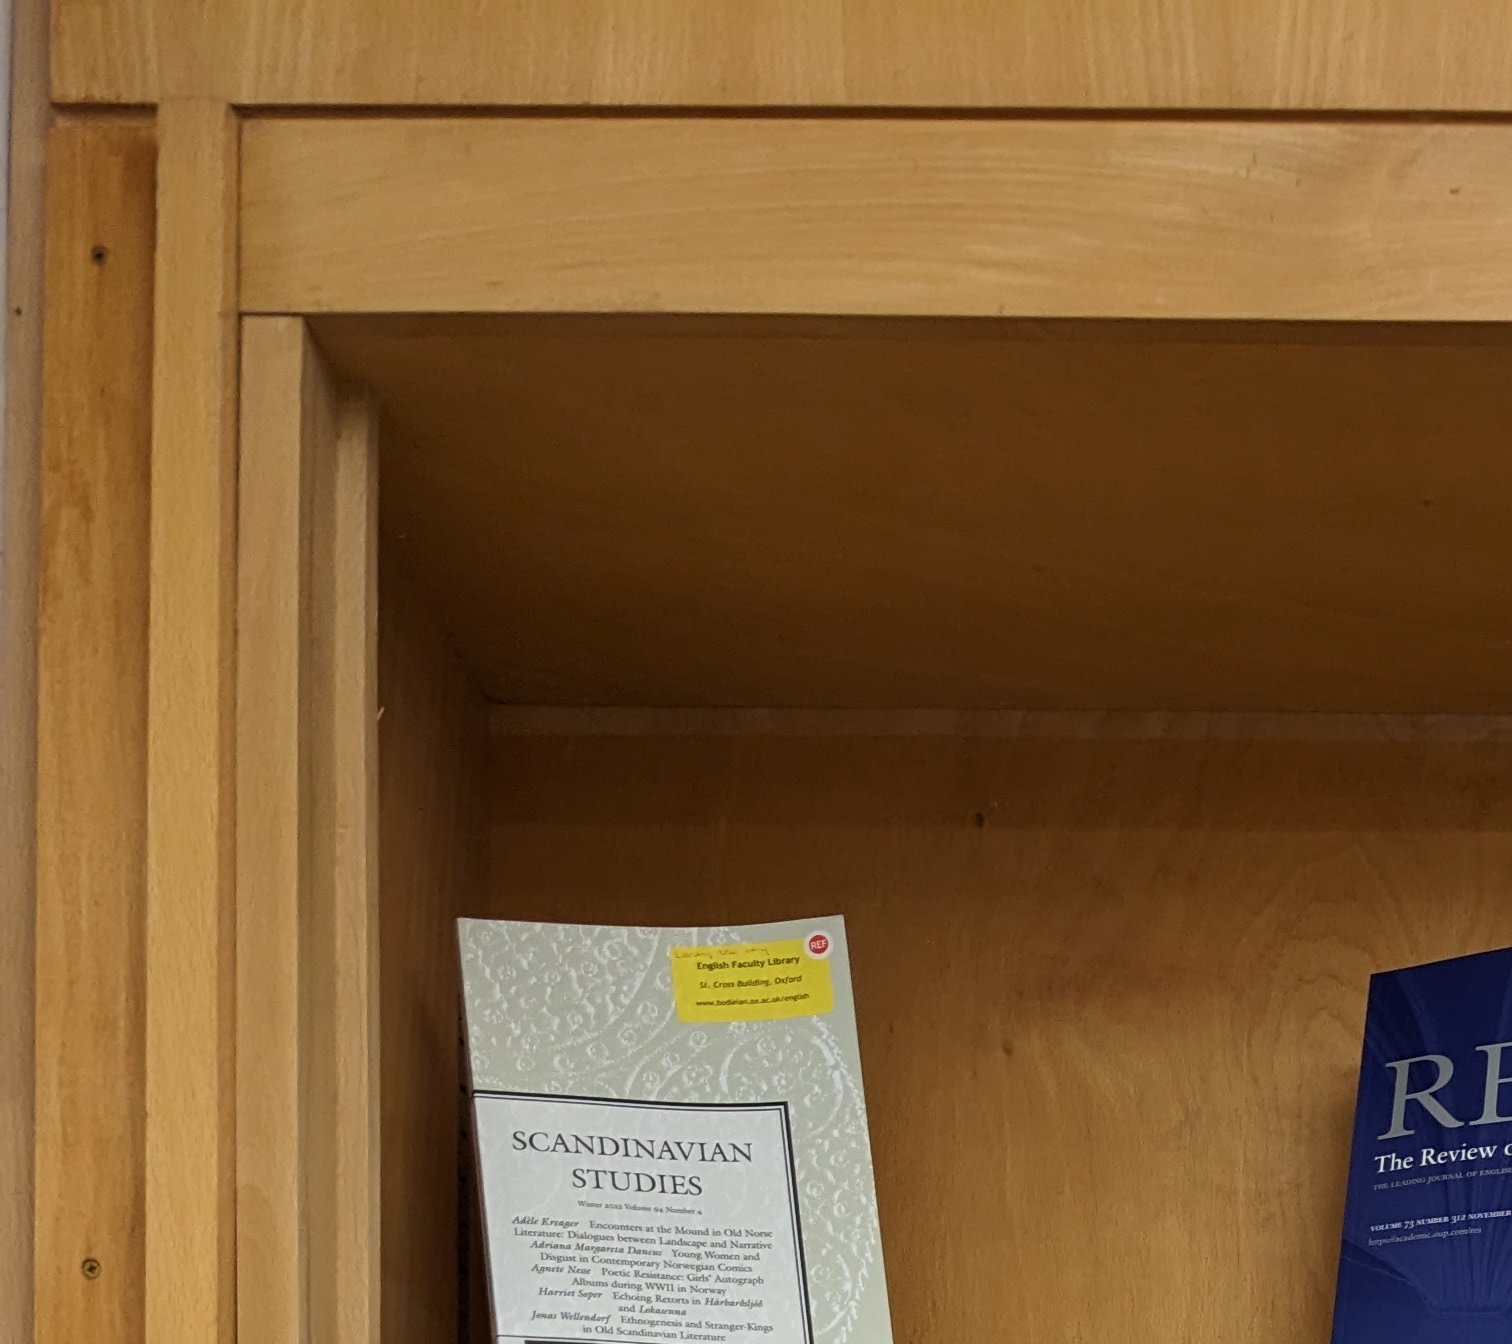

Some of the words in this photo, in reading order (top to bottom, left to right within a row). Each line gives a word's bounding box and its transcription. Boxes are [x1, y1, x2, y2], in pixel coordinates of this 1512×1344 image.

[512, 1131, 752, 1162] SCANDINAVIAN
[1374, 1154, 1414, 1174] The
[1420, 1142, 1497, 1166] Review
[572, 1169, 703, 1196] STUDIES
[514, 1228, 565, 1239] Literature:
[567, 1230, 614, 1243] Dialogues
[618, 1233, 656, 1245] between
[659, 1237, 706, 1248] Landscape
[710, 1239, 727, 1248] and
[730, 1241, 772, 1250] Narrative
[583, 1325, 592, 1333] in
[595, 1326, 614, 1335] Old
[617, 1327, 677, 1339] Scandinavian
[680, 1331, 725, 1341] Literature
